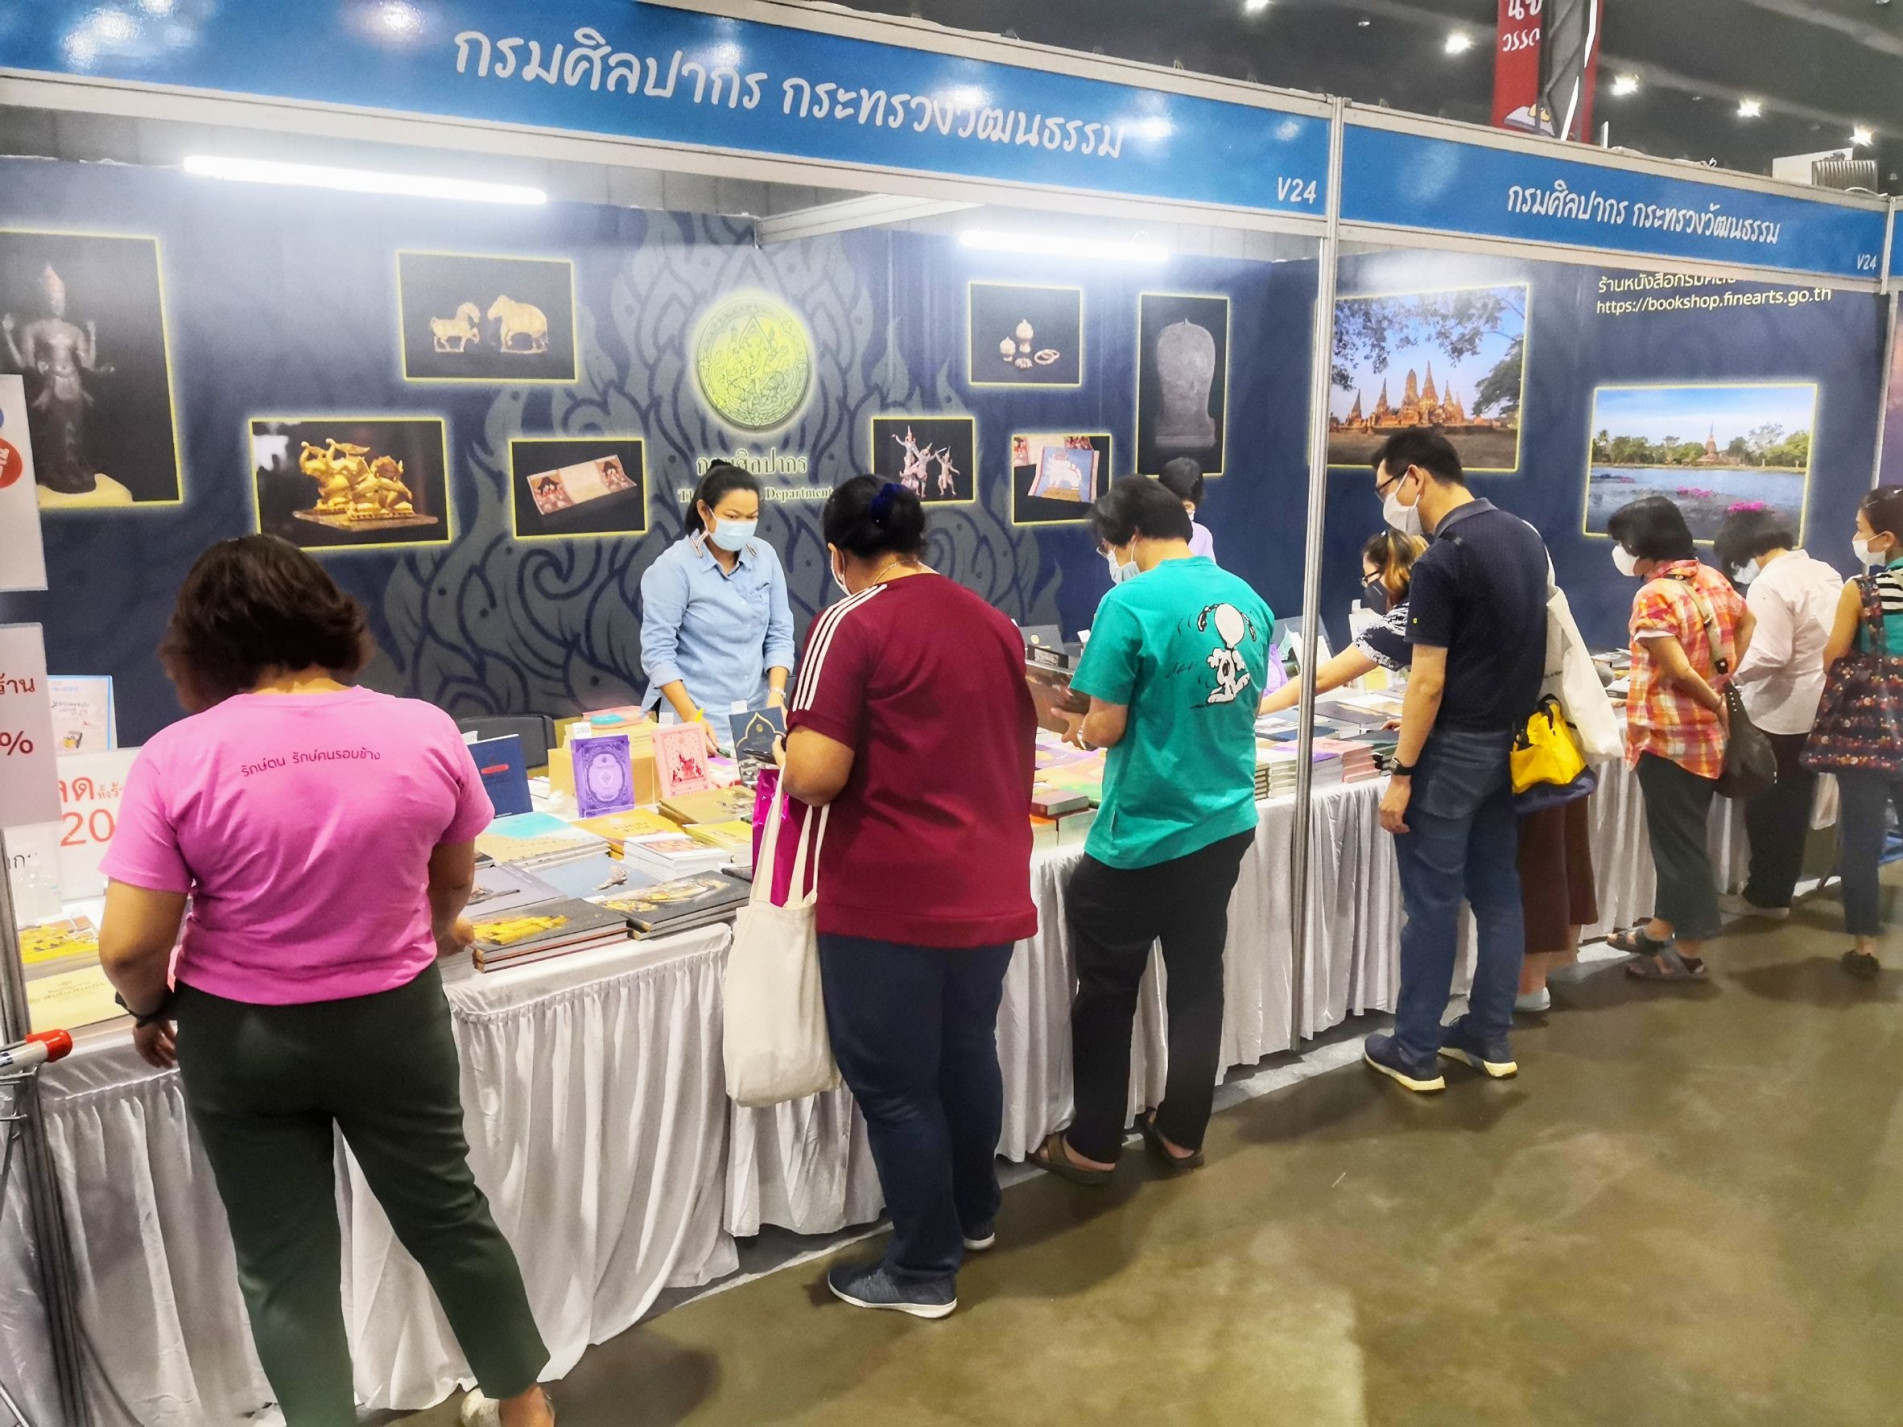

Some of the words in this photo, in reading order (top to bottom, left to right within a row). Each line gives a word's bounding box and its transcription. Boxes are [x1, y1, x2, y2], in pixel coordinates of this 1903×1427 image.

[454, 27, 768, 109] กรมศิลปากร
[1278, 176, 1317, 205] V24
[1507, 179, 1629, 224] กรมศิลปากร
[1632, 202, 1780, 244] กระทรวงวัฒนธรรม
[1857, 253, 1877, 270] V24
[1596, 287, 1832, 316] https://bookshop.finearts.go.th
[241, 757, 286, 777] รักษ์ตน
[292, 747, 381, 764] รักษ์คนรอบข้าง
